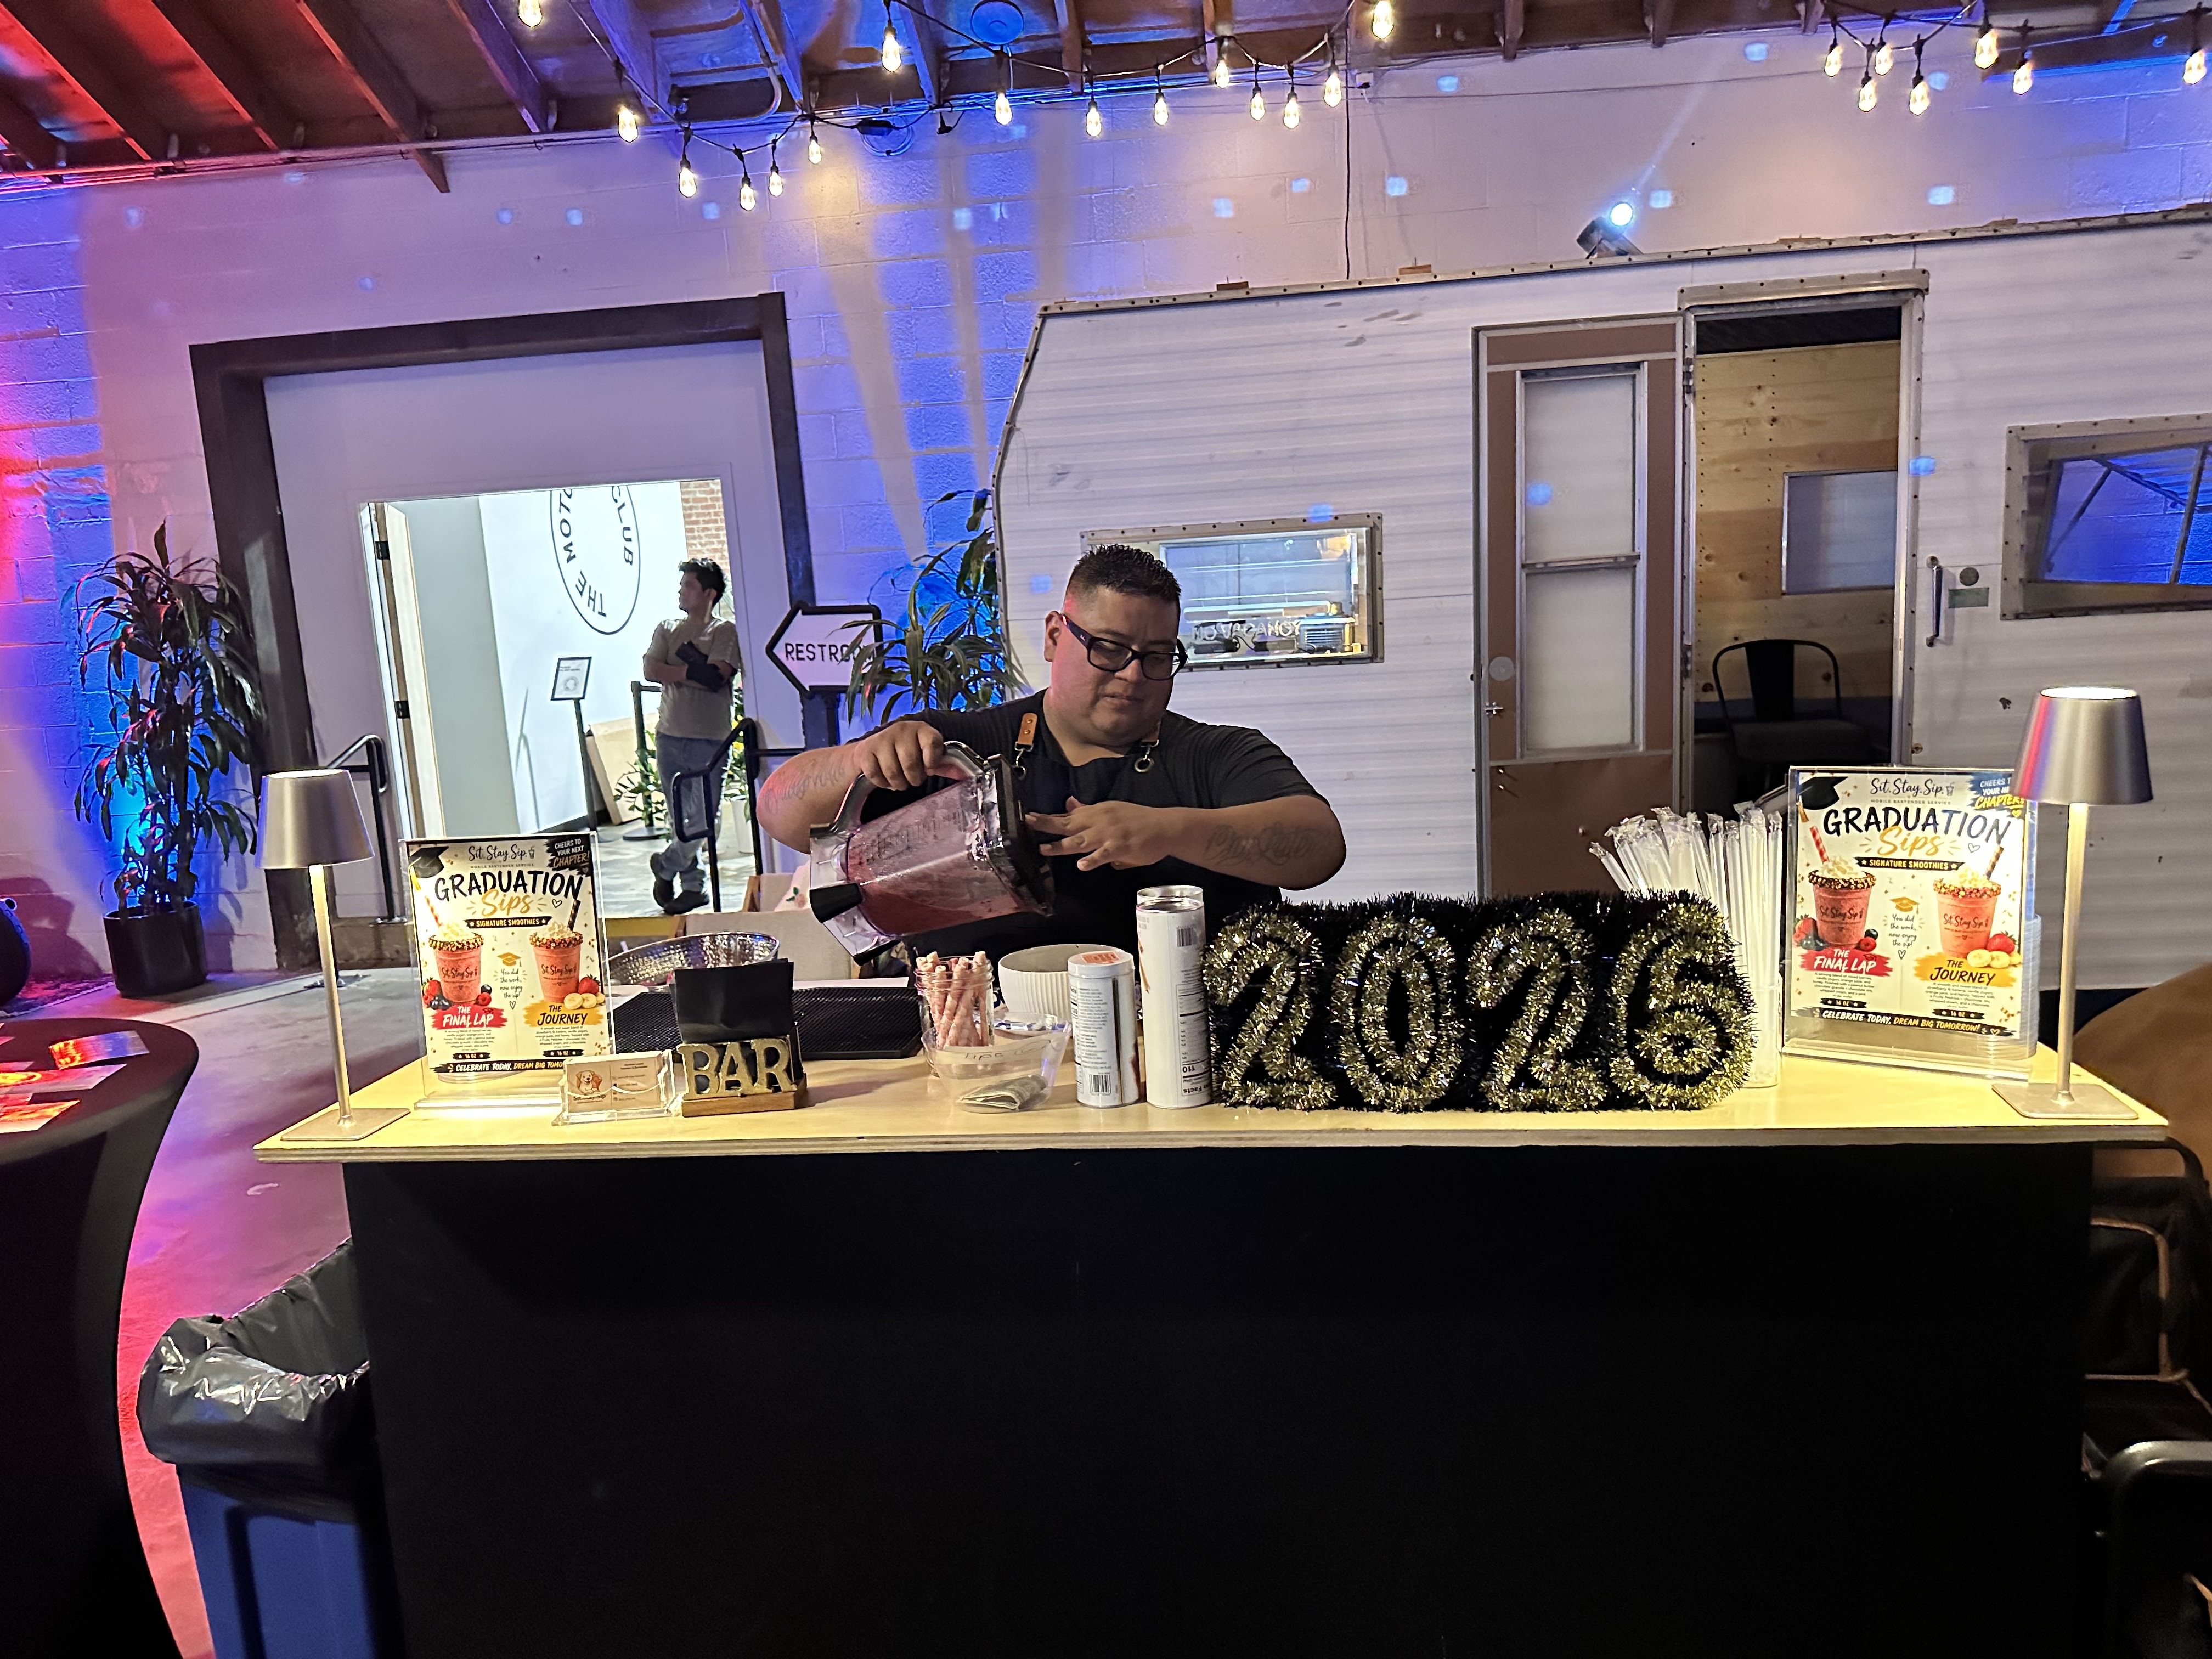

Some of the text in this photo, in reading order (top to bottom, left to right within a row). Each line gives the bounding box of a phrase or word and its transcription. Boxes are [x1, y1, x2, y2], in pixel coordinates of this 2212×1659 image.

[575, 569, 607, 618] THE
[611, 486, 633, 566] CLUB
[785, 642, 876, 662] RESTRO
[1980, 778, 2006, 788] CHEERS
[1982, 787, 2000, 795] YOUR
[1823, 806, 2011, 845] GRADUATION
[554, 840, 574, 850] CHEERS
[1877, 825, 1944, 857] Sips
[552, 850, 590, 868] CHAPTER!
[557, 848, 571, 856] YOUR
[1869, 859, 1949, 870] SIGNATURE SMOOTHIES
[435, 870, 583, 901] GRADUATION
[482, 888, 534, 917] Sips
[1833, 949, 1850, 957] THE
[1813, 956, 1876, 974] FINAL LAP
[1947, 960, 1964, 968] THE
[1929, 967, 1996, 986] JOURNEY
[1203, 902, 1754, 1110] 2026
[443, 1013, 494, 1028] FINAL LAP
[537, 1012, 588, 1026] JOURNEY
[1822, 1010, 1865, 1021] CELEBRATE
[1893, 1017, 1919, 1026] DREAM
[1920, 1019, 1934, 1028] BIG
[1936, 1020, 1980, 1032] TOMORROW!
[455, 1063, 490, 1071] CELEBRATE
[678, 1037, 797, 1101] BAR
[1183, 1084, 1202, 1093] Facts
